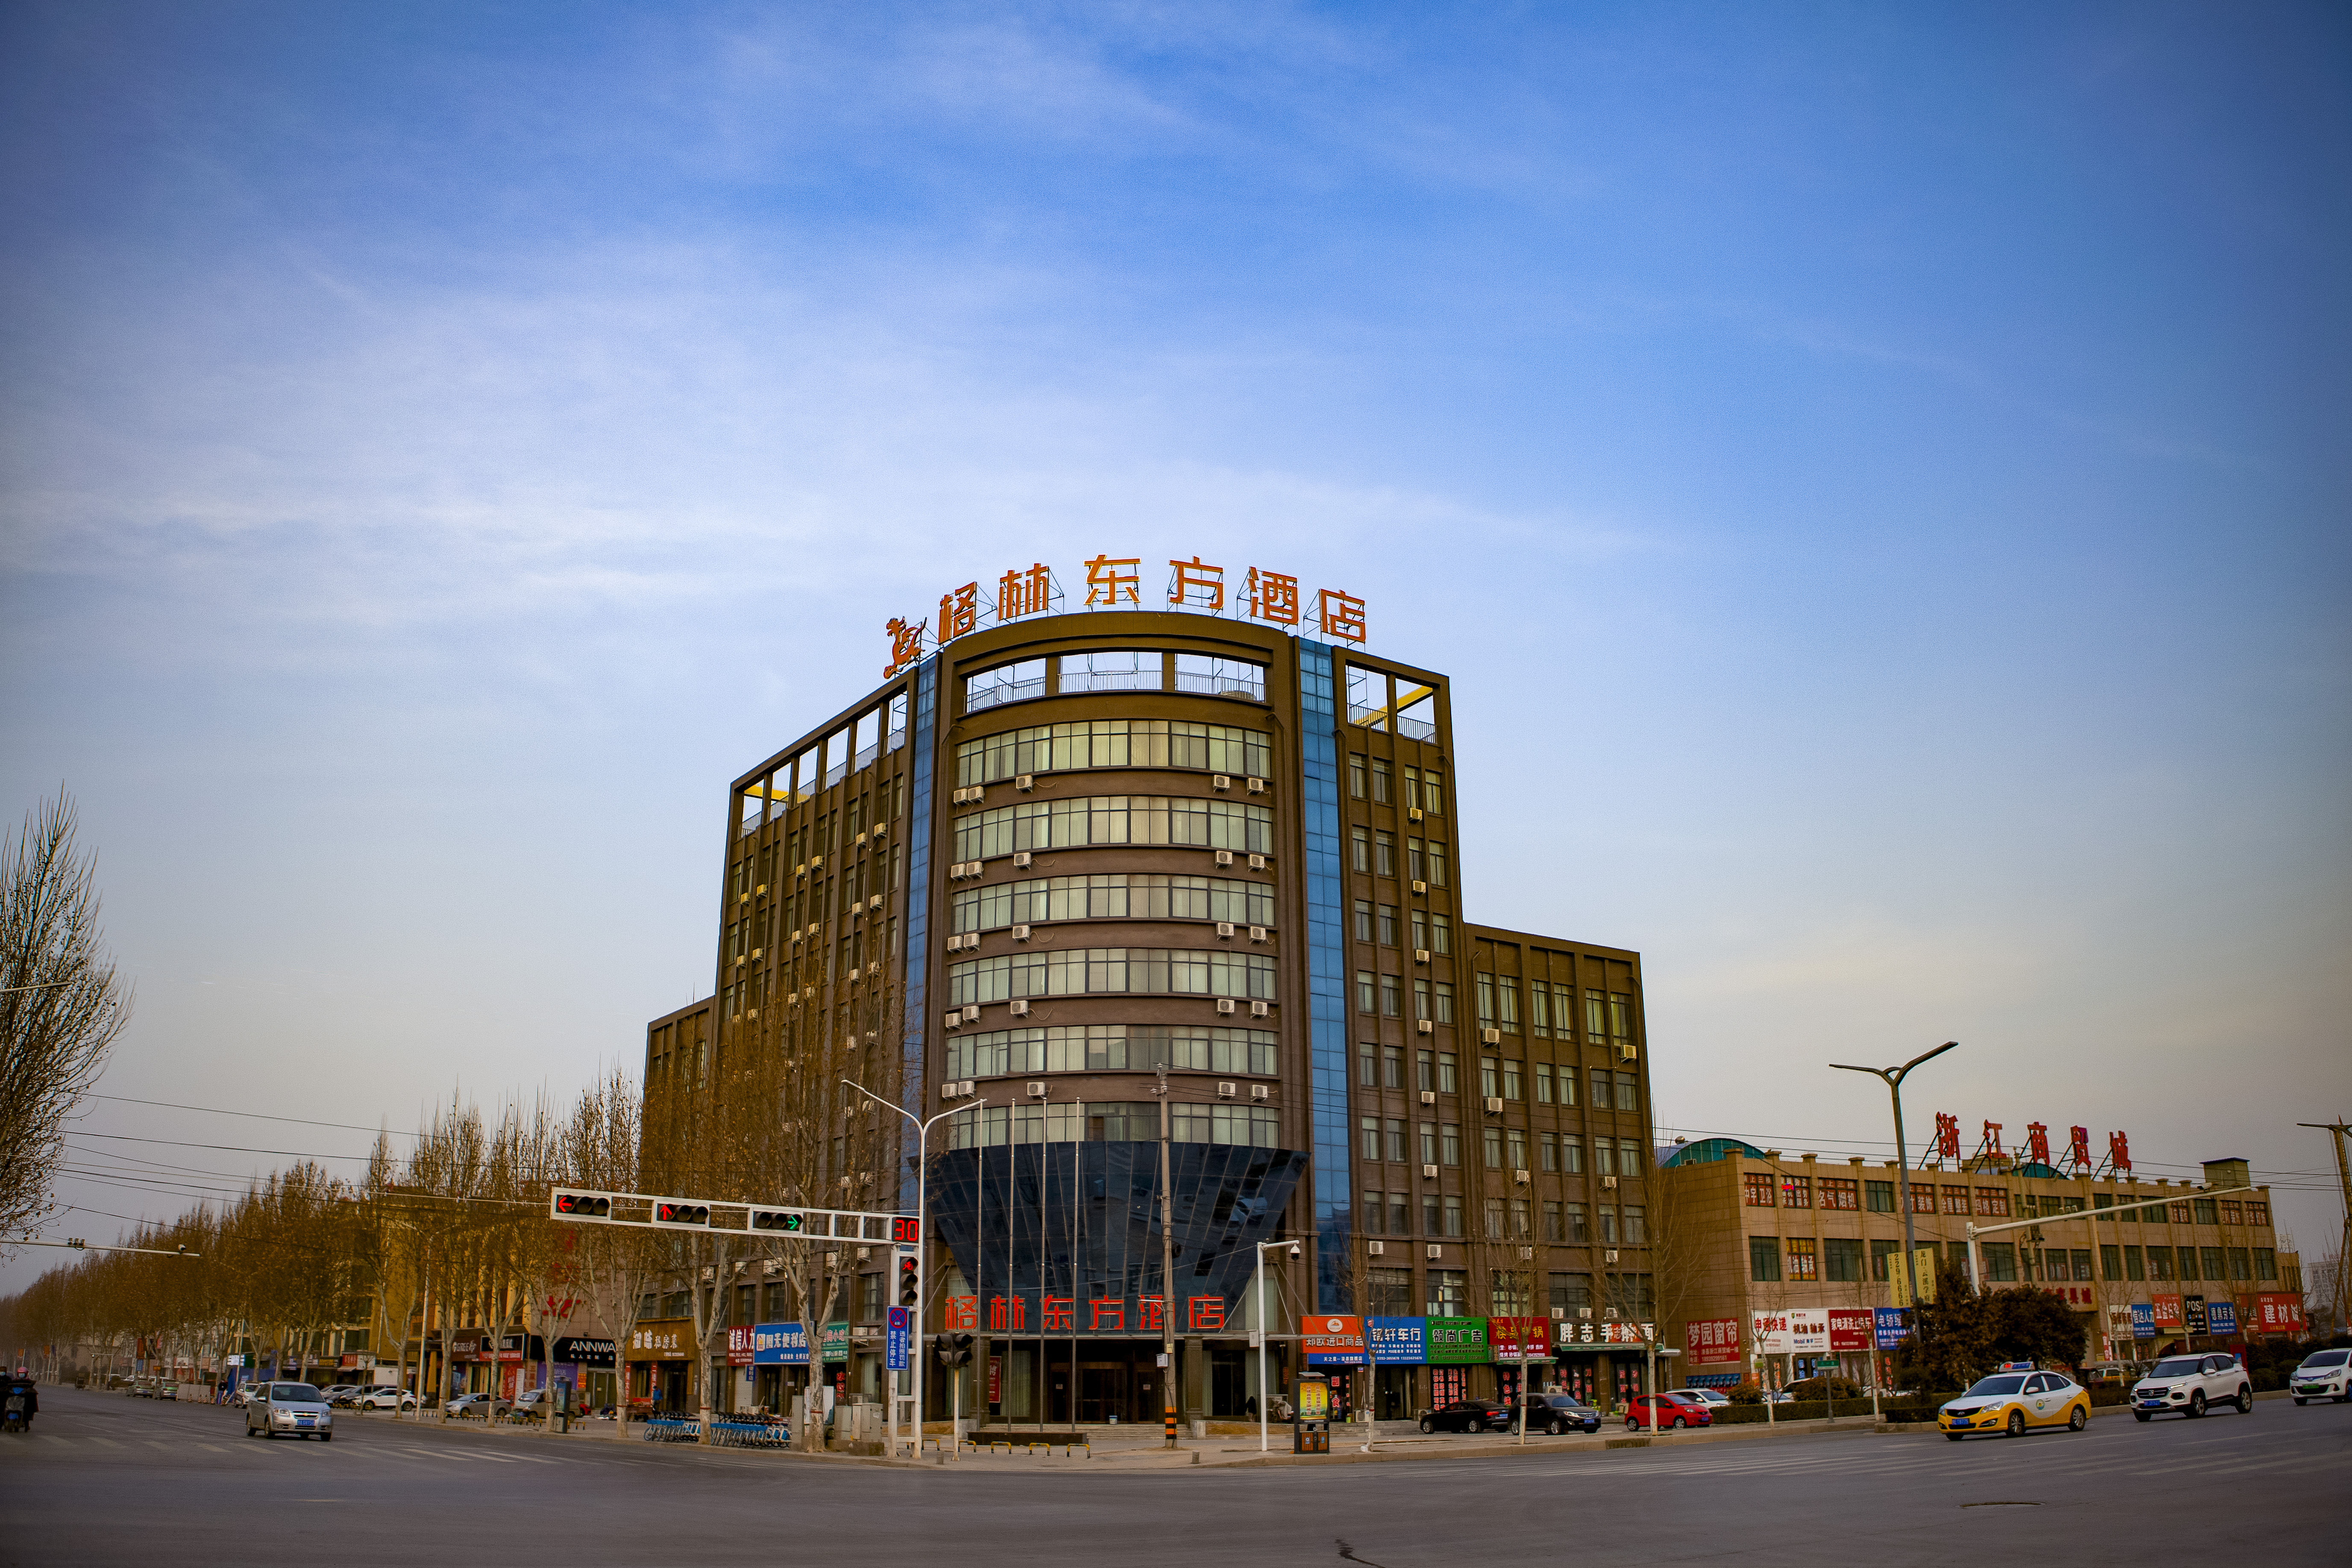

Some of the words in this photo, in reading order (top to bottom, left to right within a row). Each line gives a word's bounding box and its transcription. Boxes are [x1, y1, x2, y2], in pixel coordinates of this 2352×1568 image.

[938, 554, 1366, 644] 格林东方酒店
[1936, 1111, 2132, 1171] 浙江商贸城
[1818, 1190, 1856, 1208] 名气烟机
[895, 1219, 918, 1241] 30
[945, 1294, 1225, 1330] 格林东方酒店
[823, 1329, 845, 1342] 梅小吃
[1688, 1319, 1737, 1347] 梦园窗帘
[1755, 1317, 1787, 1332] 申通快递
[729, 1328, 755, 1351] 诚信人力
[1306, 1336, 1363, 1346] 郑欧进口商品
[1433, 1329, 1482, 1343] 领尚广告
[1331, 1377, 1340, 1407] 副食
